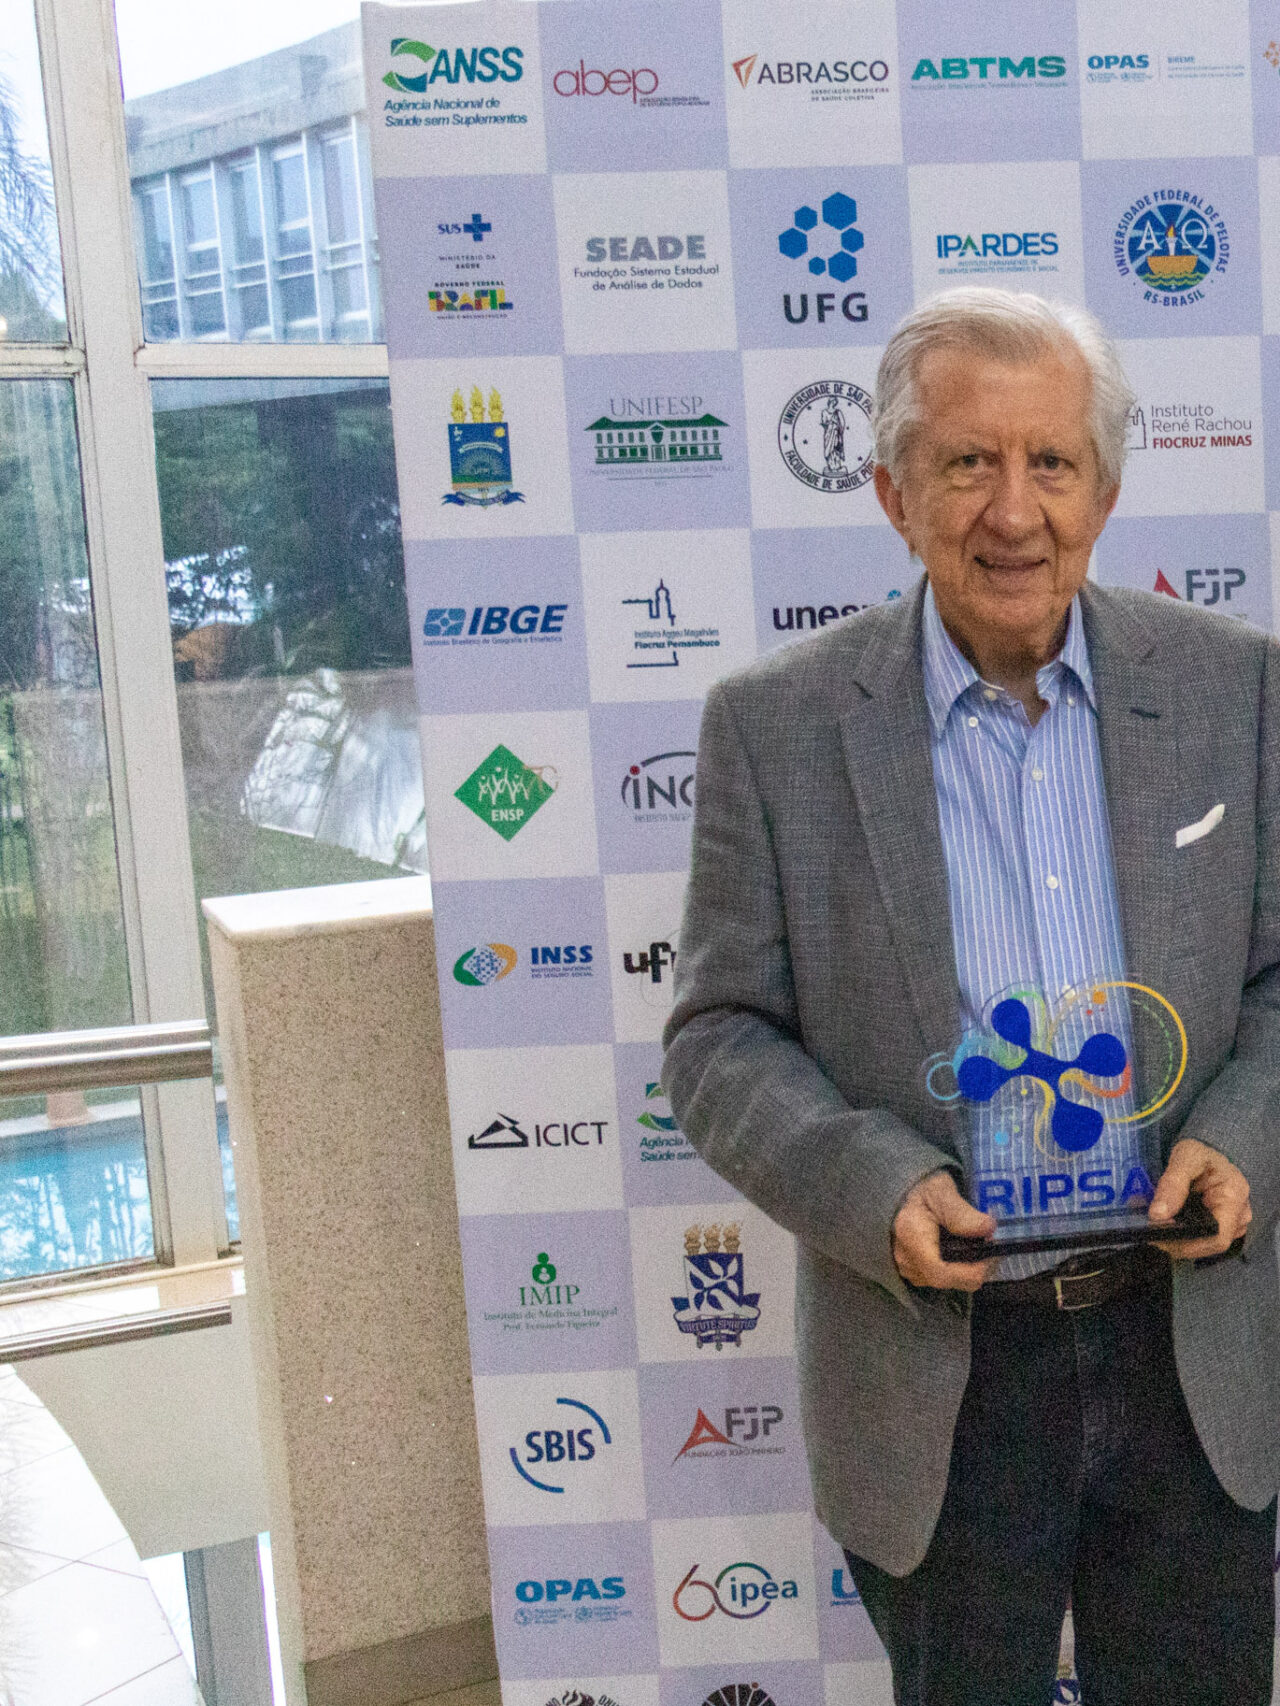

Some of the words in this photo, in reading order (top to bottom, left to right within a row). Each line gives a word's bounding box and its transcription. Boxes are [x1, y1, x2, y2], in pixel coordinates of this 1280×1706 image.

[429, 46, 524, 84] ANSS
[757, 60, 889, 85] ABRASCO
[911, 55, 1067, 81] ABTMS
[1087, 54, 1150, 69] OPAS
[553, 59, 659, 104] abep
[384, 100, 431, 113] Agência
[433, 98, 484, 110] Nacional
[485, 98, 500, 109] de
[385, 115, 422, 127] Saúde
[424, 117, 449, 126] sem
[452, 113, 528, 127] Suplementos
[438, 224, 461, 234] SUS
[1114, 196, 1152, 276] UNIVERSIDADE
[1153, 190, 1204, 209] FEDERAL
[1204, 205, 1219, 222] DE
[1215, 221, 1230, 274] PELOTAS
[586, 235, 706, 262] SEADE
[937, 232, 1059, 258] IPARDES
[574, 267, 627, 279] Fundação
[630, 266, 671, 276] Sistema
[674, 264, 719, 275] Estadual
[593, 281, 606, 291] de
[609, 280, 648, 290] Análise
[651, 279, 664, 289] de
[668, 278, 703, 289] Dados
[783, 293, 869, 324] UFG
[610, 396, 703, 416] UNIFESP
[783, 384, 830, 425] UNIVERSIDADE
[834, 384, 844, 394] DE
[846, 387, 864, 402] SÃO
[1151, 404, 1214, 418] Instituto
[1152, 418, 1190, 433] René
[1195, 417, 1252, 432] Rachou
[1153, 436, 1207, 449] FIOCRUZ
[1210, 435, 1252, 447] MINAS
[1186, 567, 1246, 606] FJP
[468, 604, 568, 635] IBGE
[491, 809, 525, 823] ENSP
[531, 945, 593, 965] INSS
[535, 1122, 608, 1147] ICICT
[639, 1136, 683, 1150] Agência
[641, 1151, 675, 1162] Saúde
[978, 1167, 1154, 1215] RIPSA
[519, 1285, 580, 1306] IMIP
[725, 1405, 784, 1441] FJP
[525, 1428, 595, 1463] SBIS
[515, 1577, 626, 1603] OPAS
[730, 1576, 799, 1607] ipea
